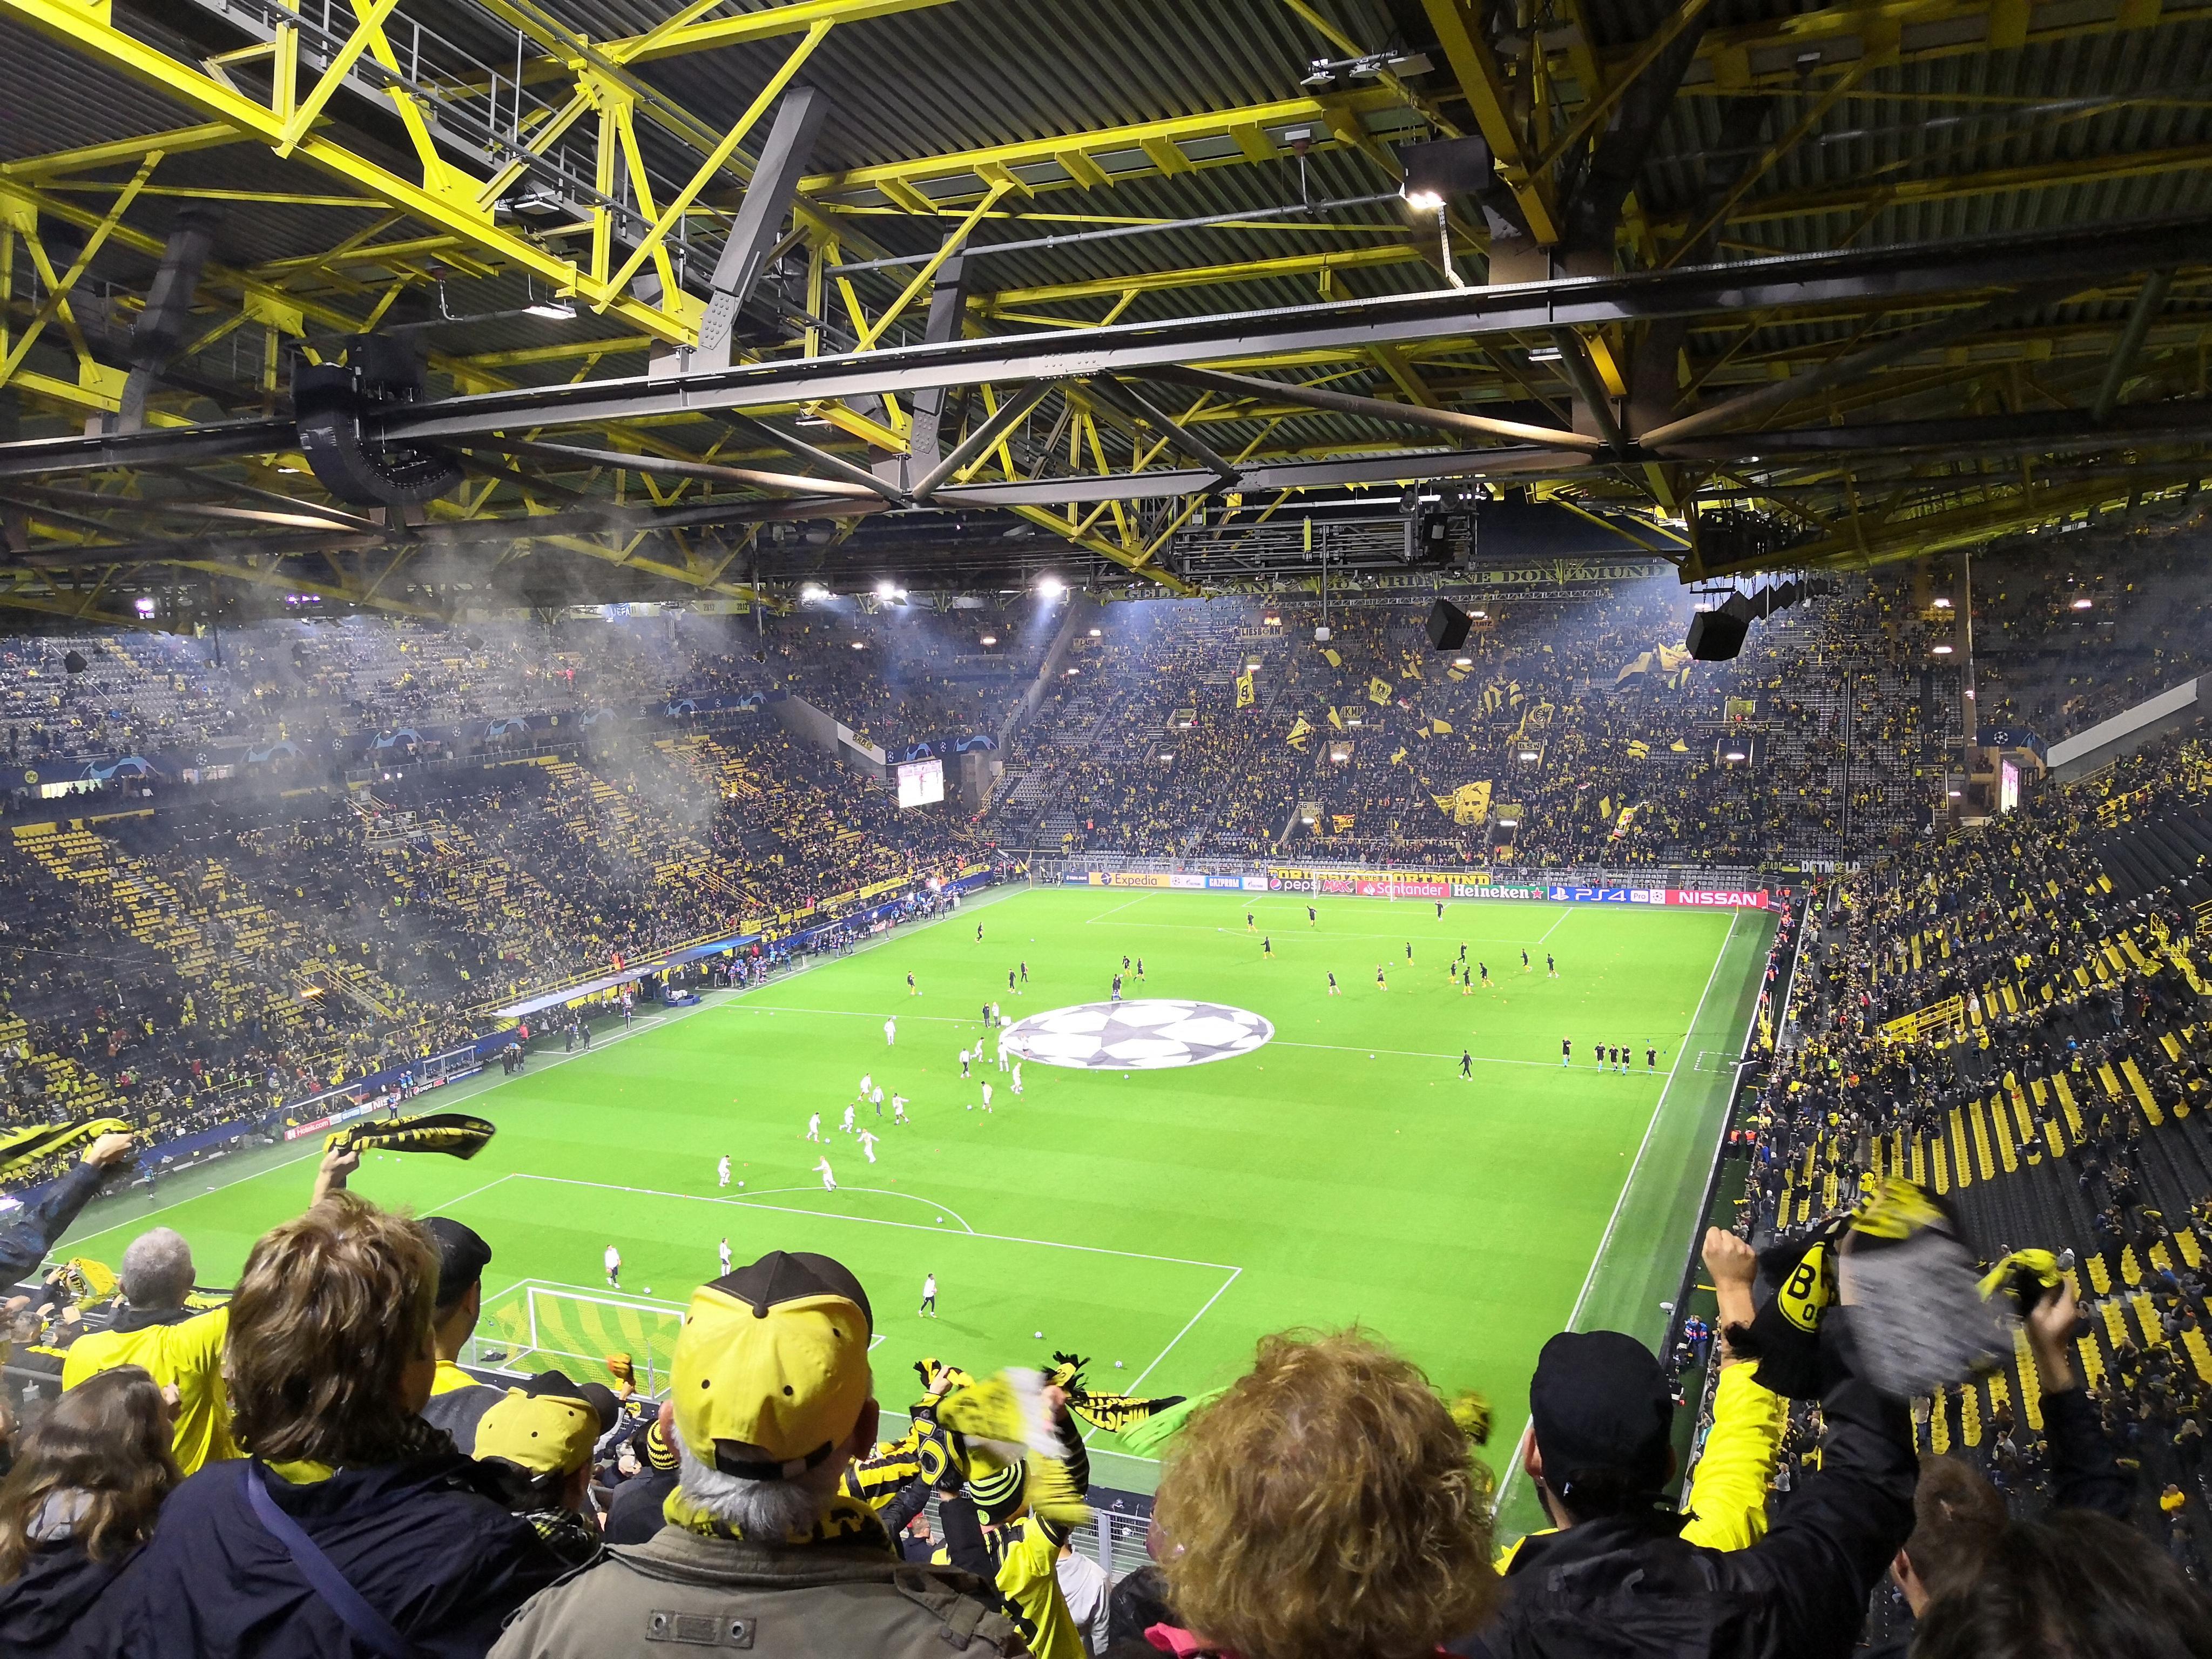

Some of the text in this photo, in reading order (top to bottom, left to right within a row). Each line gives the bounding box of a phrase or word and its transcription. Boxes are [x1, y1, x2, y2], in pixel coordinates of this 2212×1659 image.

[1115, 874, 1157, 886] Expedia
[1209, 878, 1239, 888] GAZPROM
[1284, 880, 1353, 893] pepsi MAX
[1377, 882, 1443, 896] Santander
[1453, 885, 1529, 899] Heineken
[1575, 889, 1627, 901] PS4
[1679, 891, 1757, 906] NISSAN
[420, 1082, 433, 1092] pepsi
[297, 1121, 329, 1136] Hotels.com
